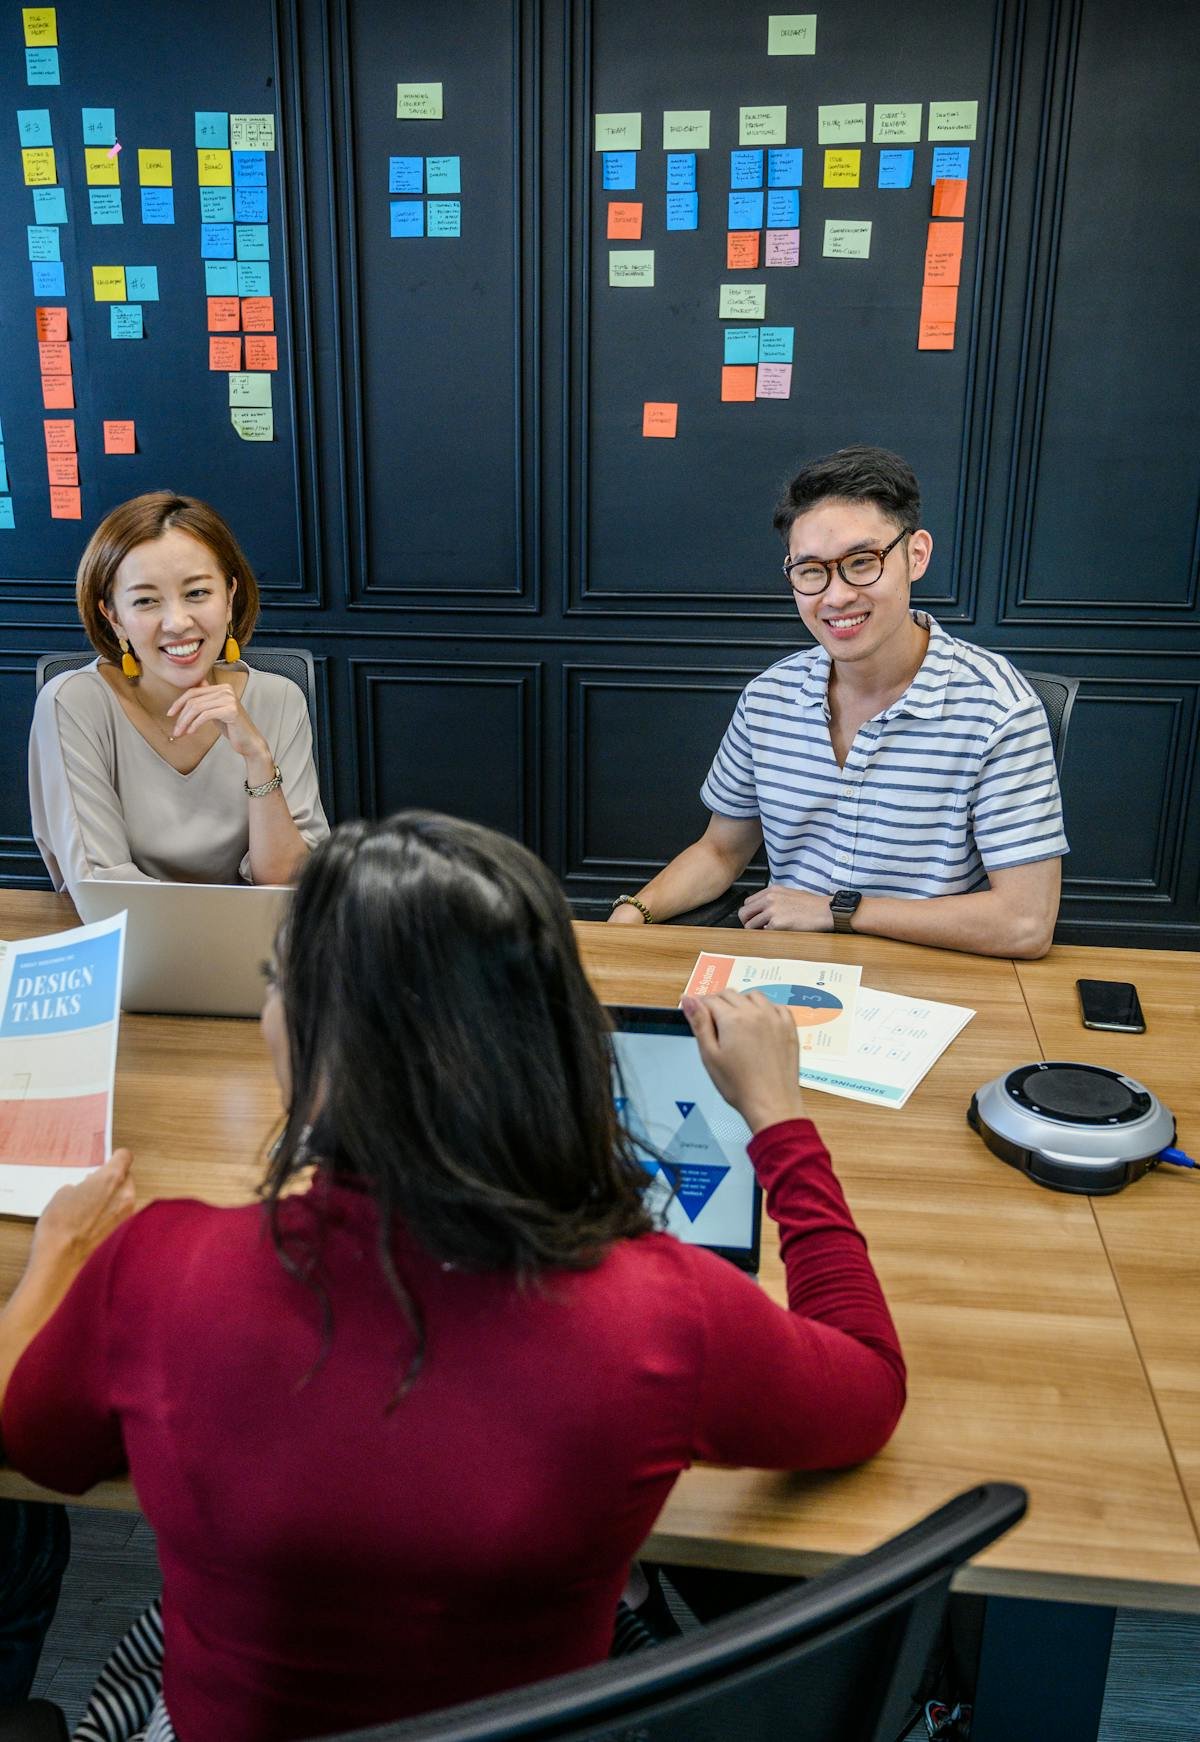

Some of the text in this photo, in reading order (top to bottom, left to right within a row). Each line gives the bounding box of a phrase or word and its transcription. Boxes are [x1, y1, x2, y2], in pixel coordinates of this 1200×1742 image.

[24, 121, 40, 133] #3
[88, 121, 104, 133] #4
[201, 125, 216, 135] #1
[604, 127, 627, 136] TEAM
[130, 279, 146, 291] #6
[16, 964, 96, 999] DESIGN
[13, 994, 82, 1024] TALKS
[799, 1072, 887, 1096] SHOPPING DECIS
